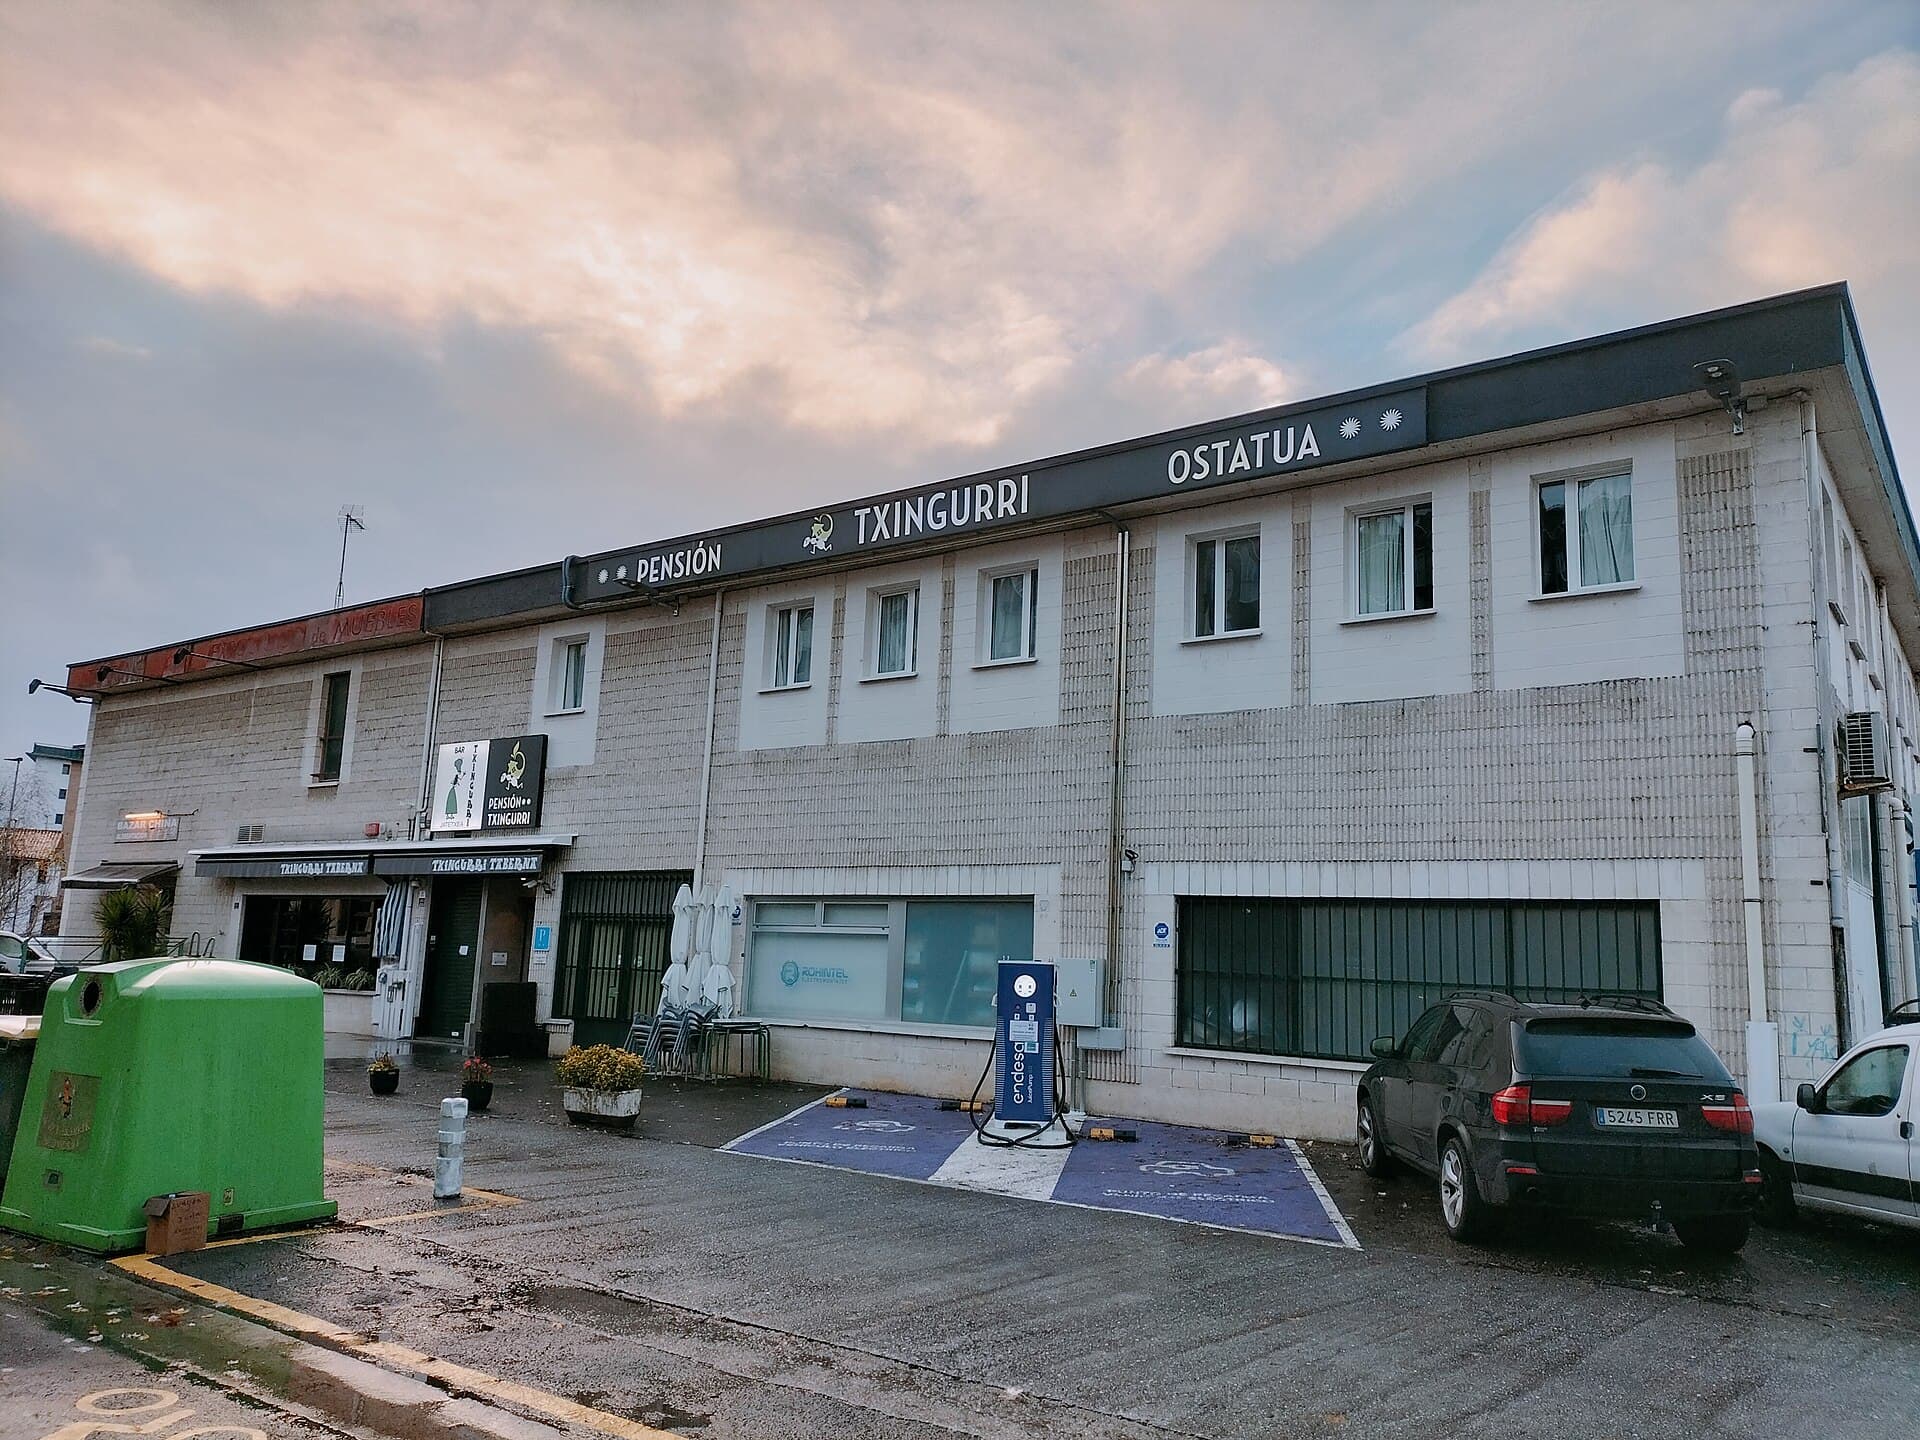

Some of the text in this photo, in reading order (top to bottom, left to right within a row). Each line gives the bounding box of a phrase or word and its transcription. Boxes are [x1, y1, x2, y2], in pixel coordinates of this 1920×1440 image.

[1168, 424, 1321, 484] OSTATUA
[637, 475, 1030, 584] PENSIÓN TXINGURRI
[454, 746, 465, 754] BAR
[488, 794, 522, 810] PENSIÓN
[117, 817, 177, 830] BAZAR CHINA
[487, 811, 531, 826] TXINGURRI
[432, 854, 538, 872] TXINGURRI TABERNA
[1010, 1042, 1025, 1104] endesa
[1607, 1110, 1675, 1126] 5245 FRR
